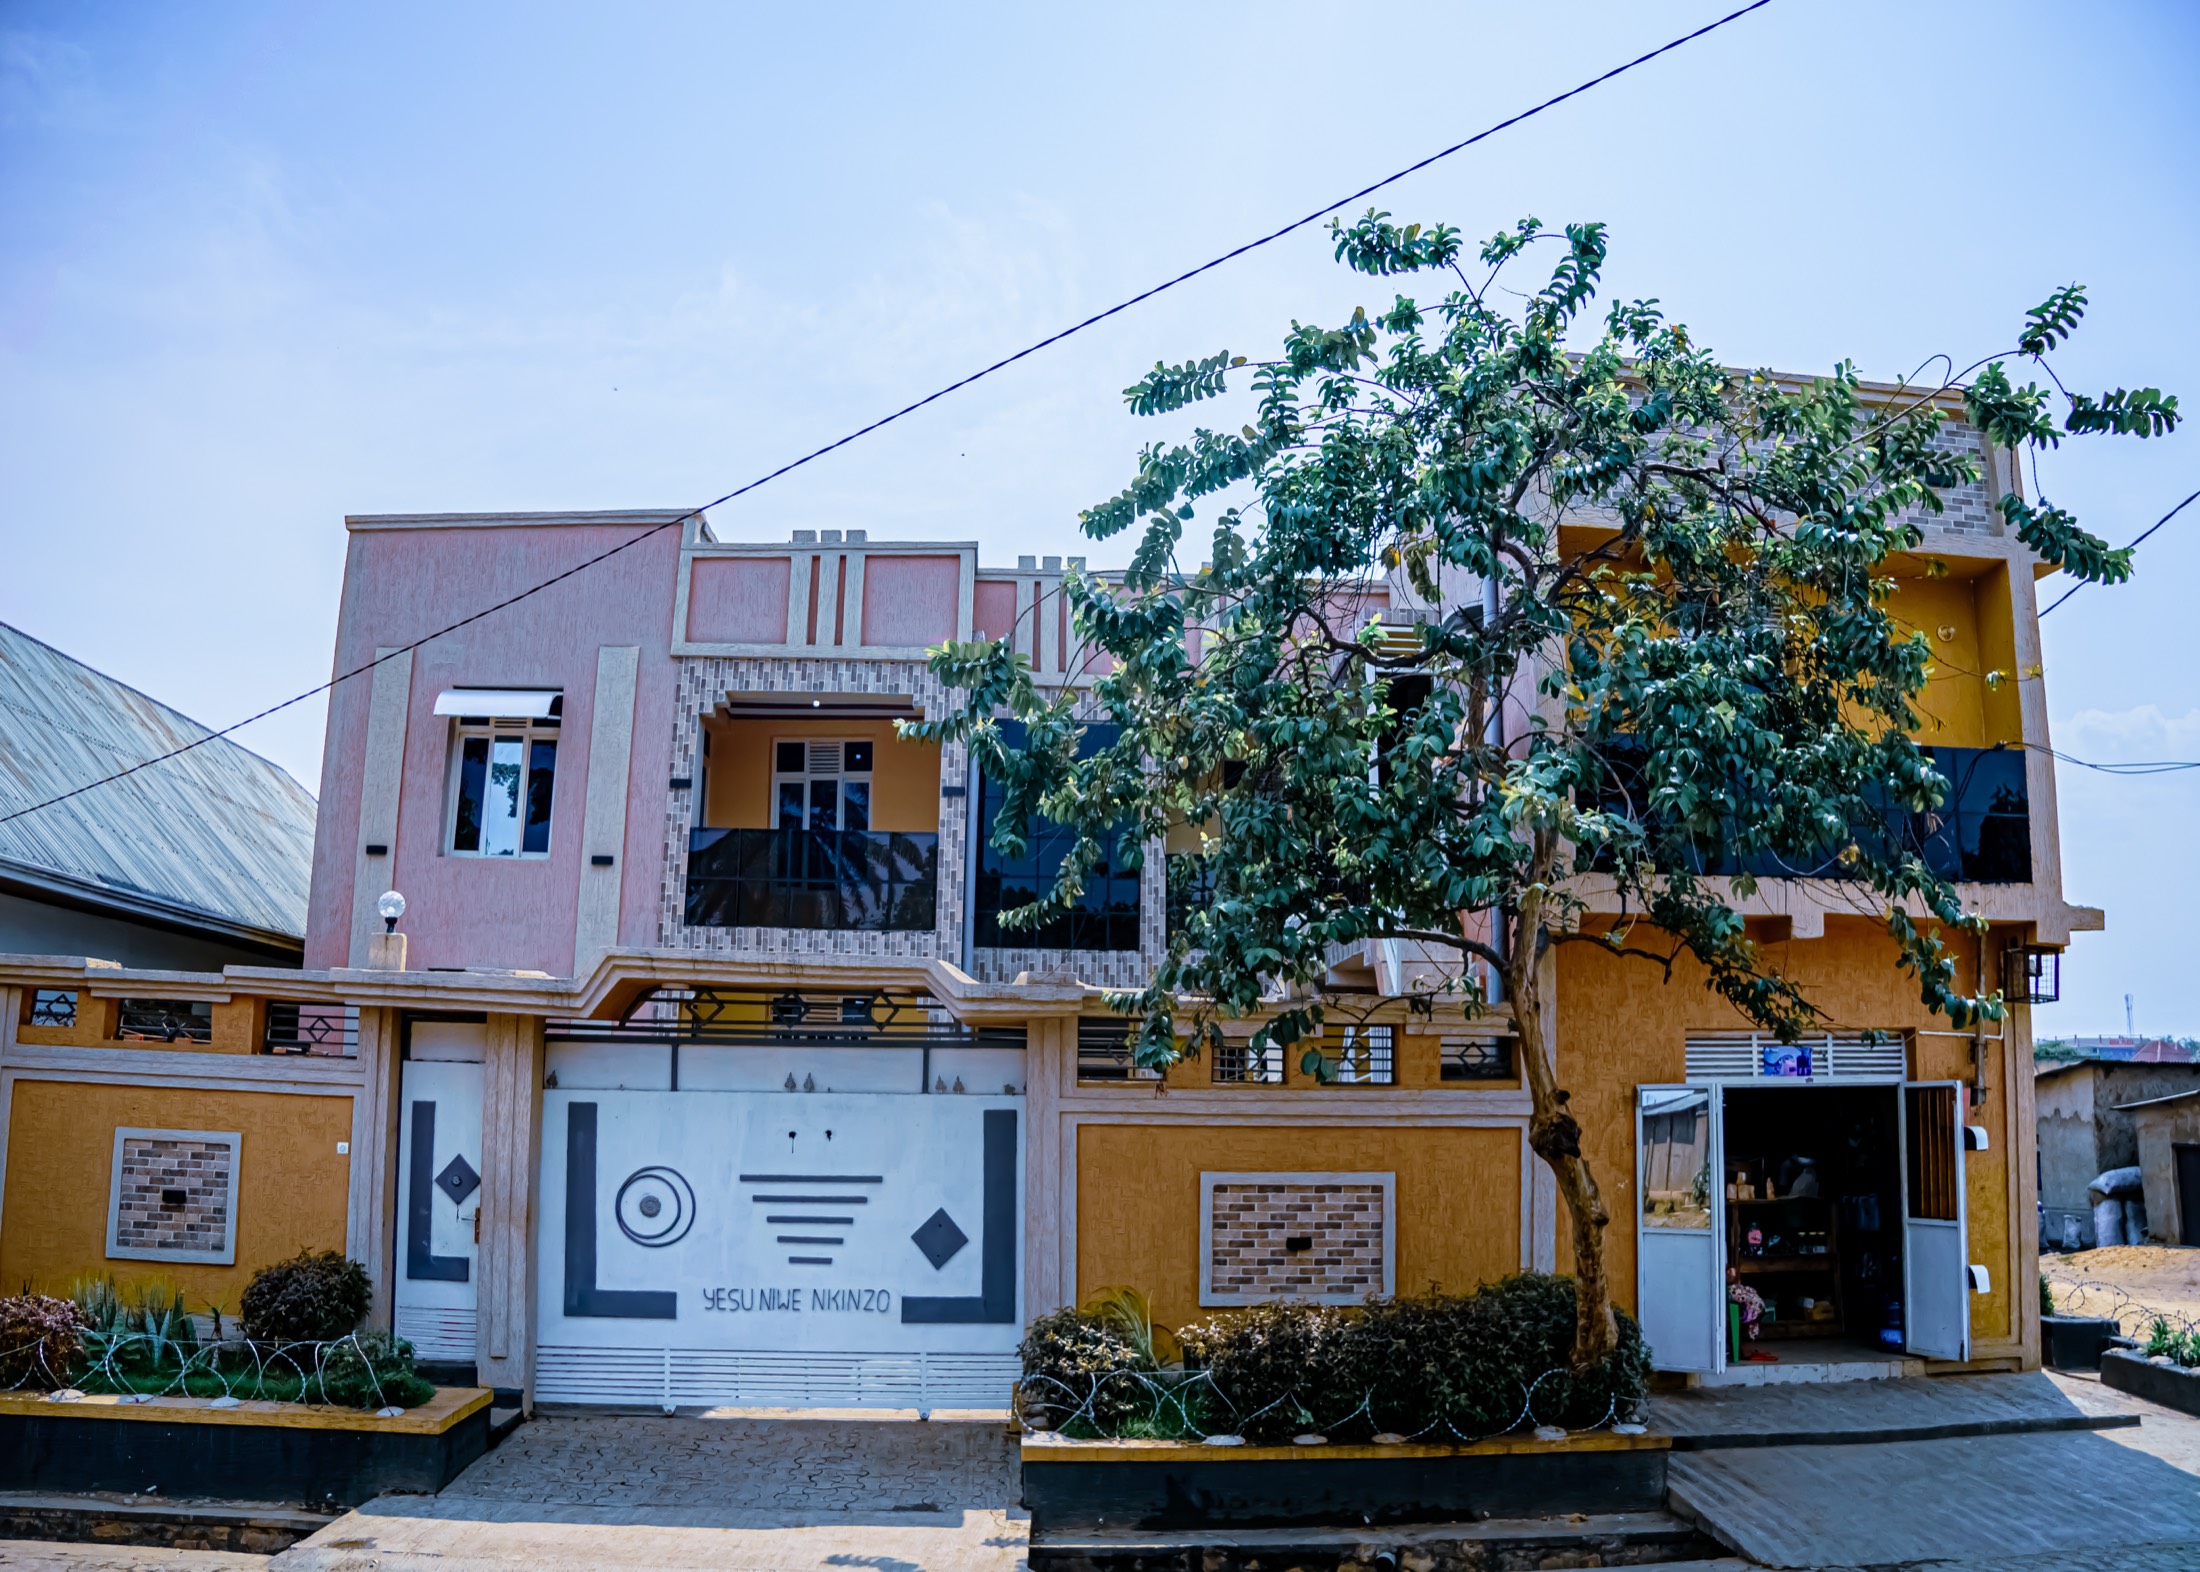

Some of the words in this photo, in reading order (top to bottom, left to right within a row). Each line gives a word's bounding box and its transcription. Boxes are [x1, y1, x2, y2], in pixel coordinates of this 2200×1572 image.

[702, 1287, 754, 1312] YESU
[758, 1287, 802, 1312] NIWE
[811, 1288, 891, 1314] NKINZO
